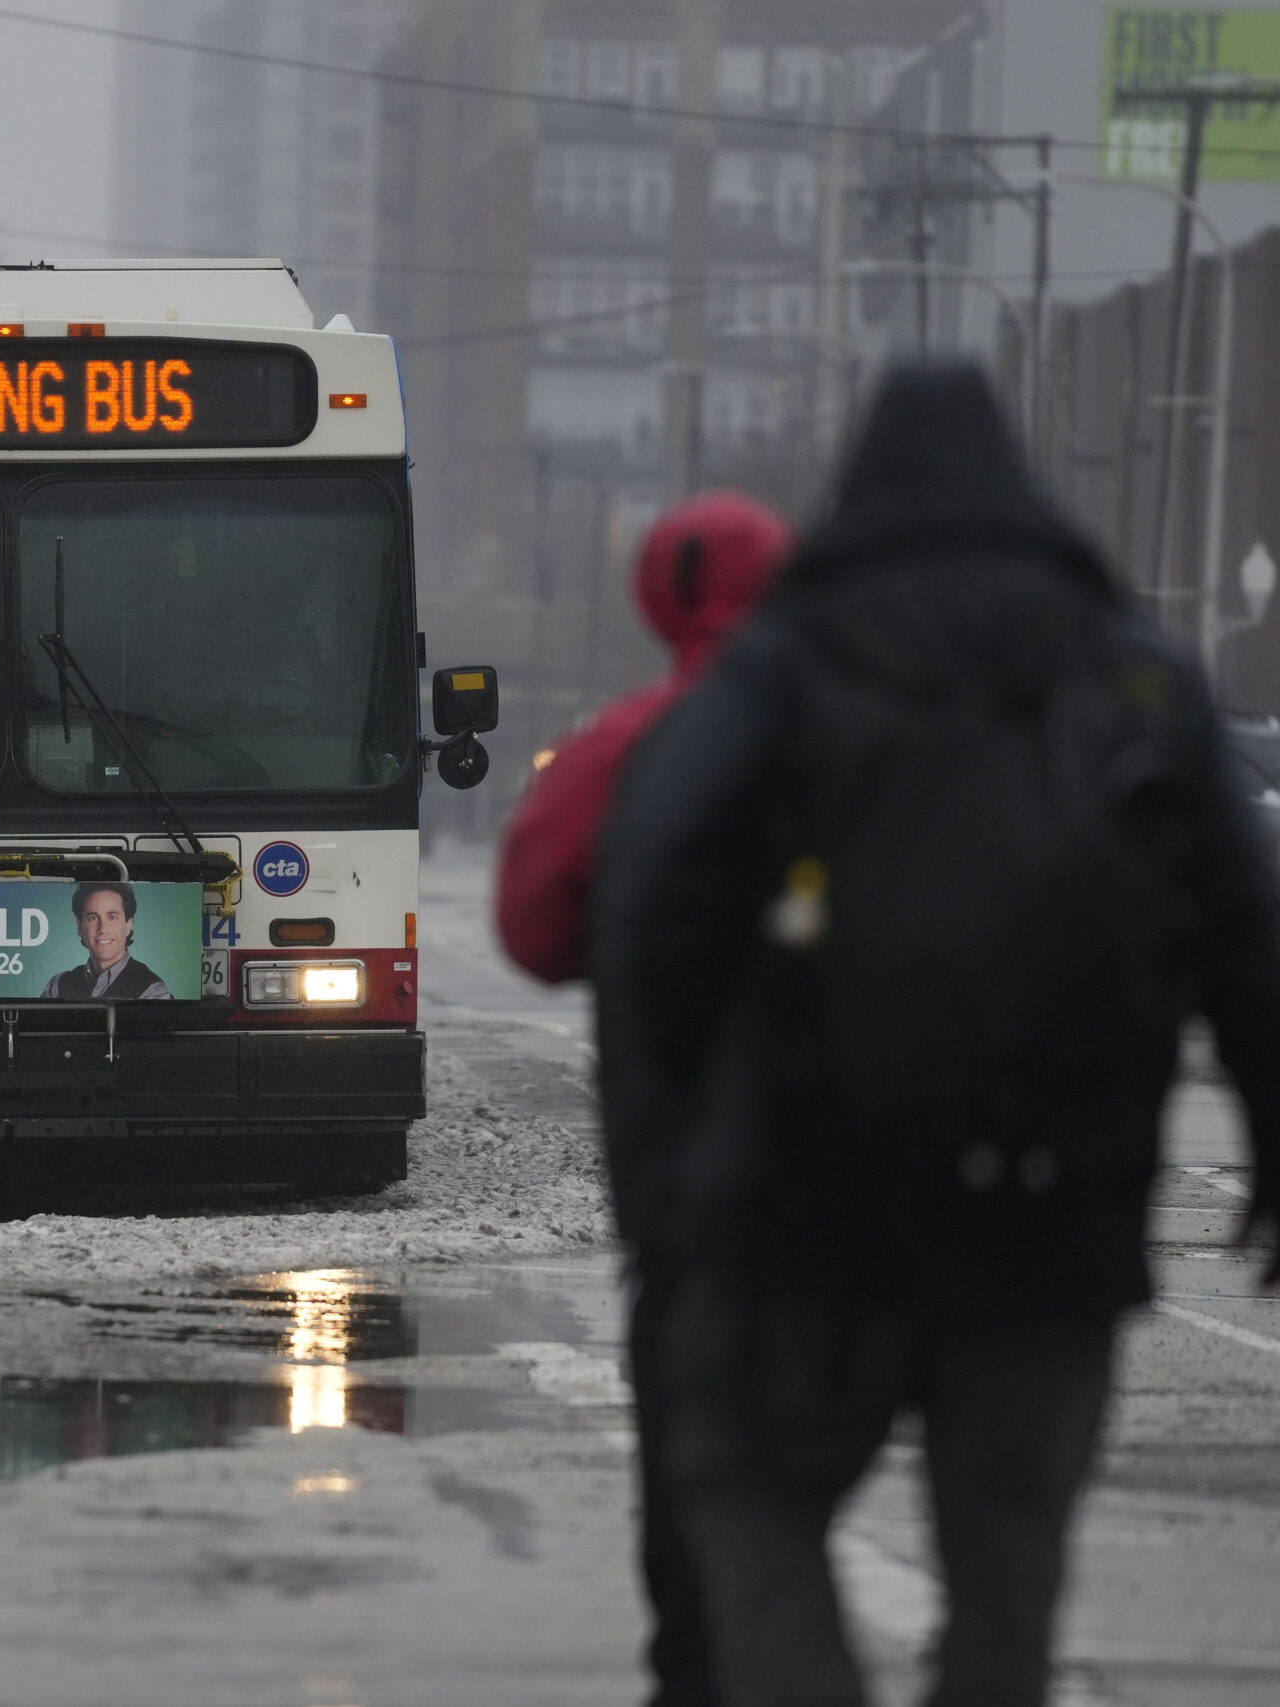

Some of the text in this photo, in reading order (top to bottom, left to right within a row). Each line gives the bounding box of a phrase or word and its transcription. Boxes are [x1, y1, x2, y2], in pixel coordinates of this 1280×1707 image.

[1114, 11, 1223, 63] FIRST
[85, 359, 194, 433] BUS
[263, 859, 299, 877] cta
